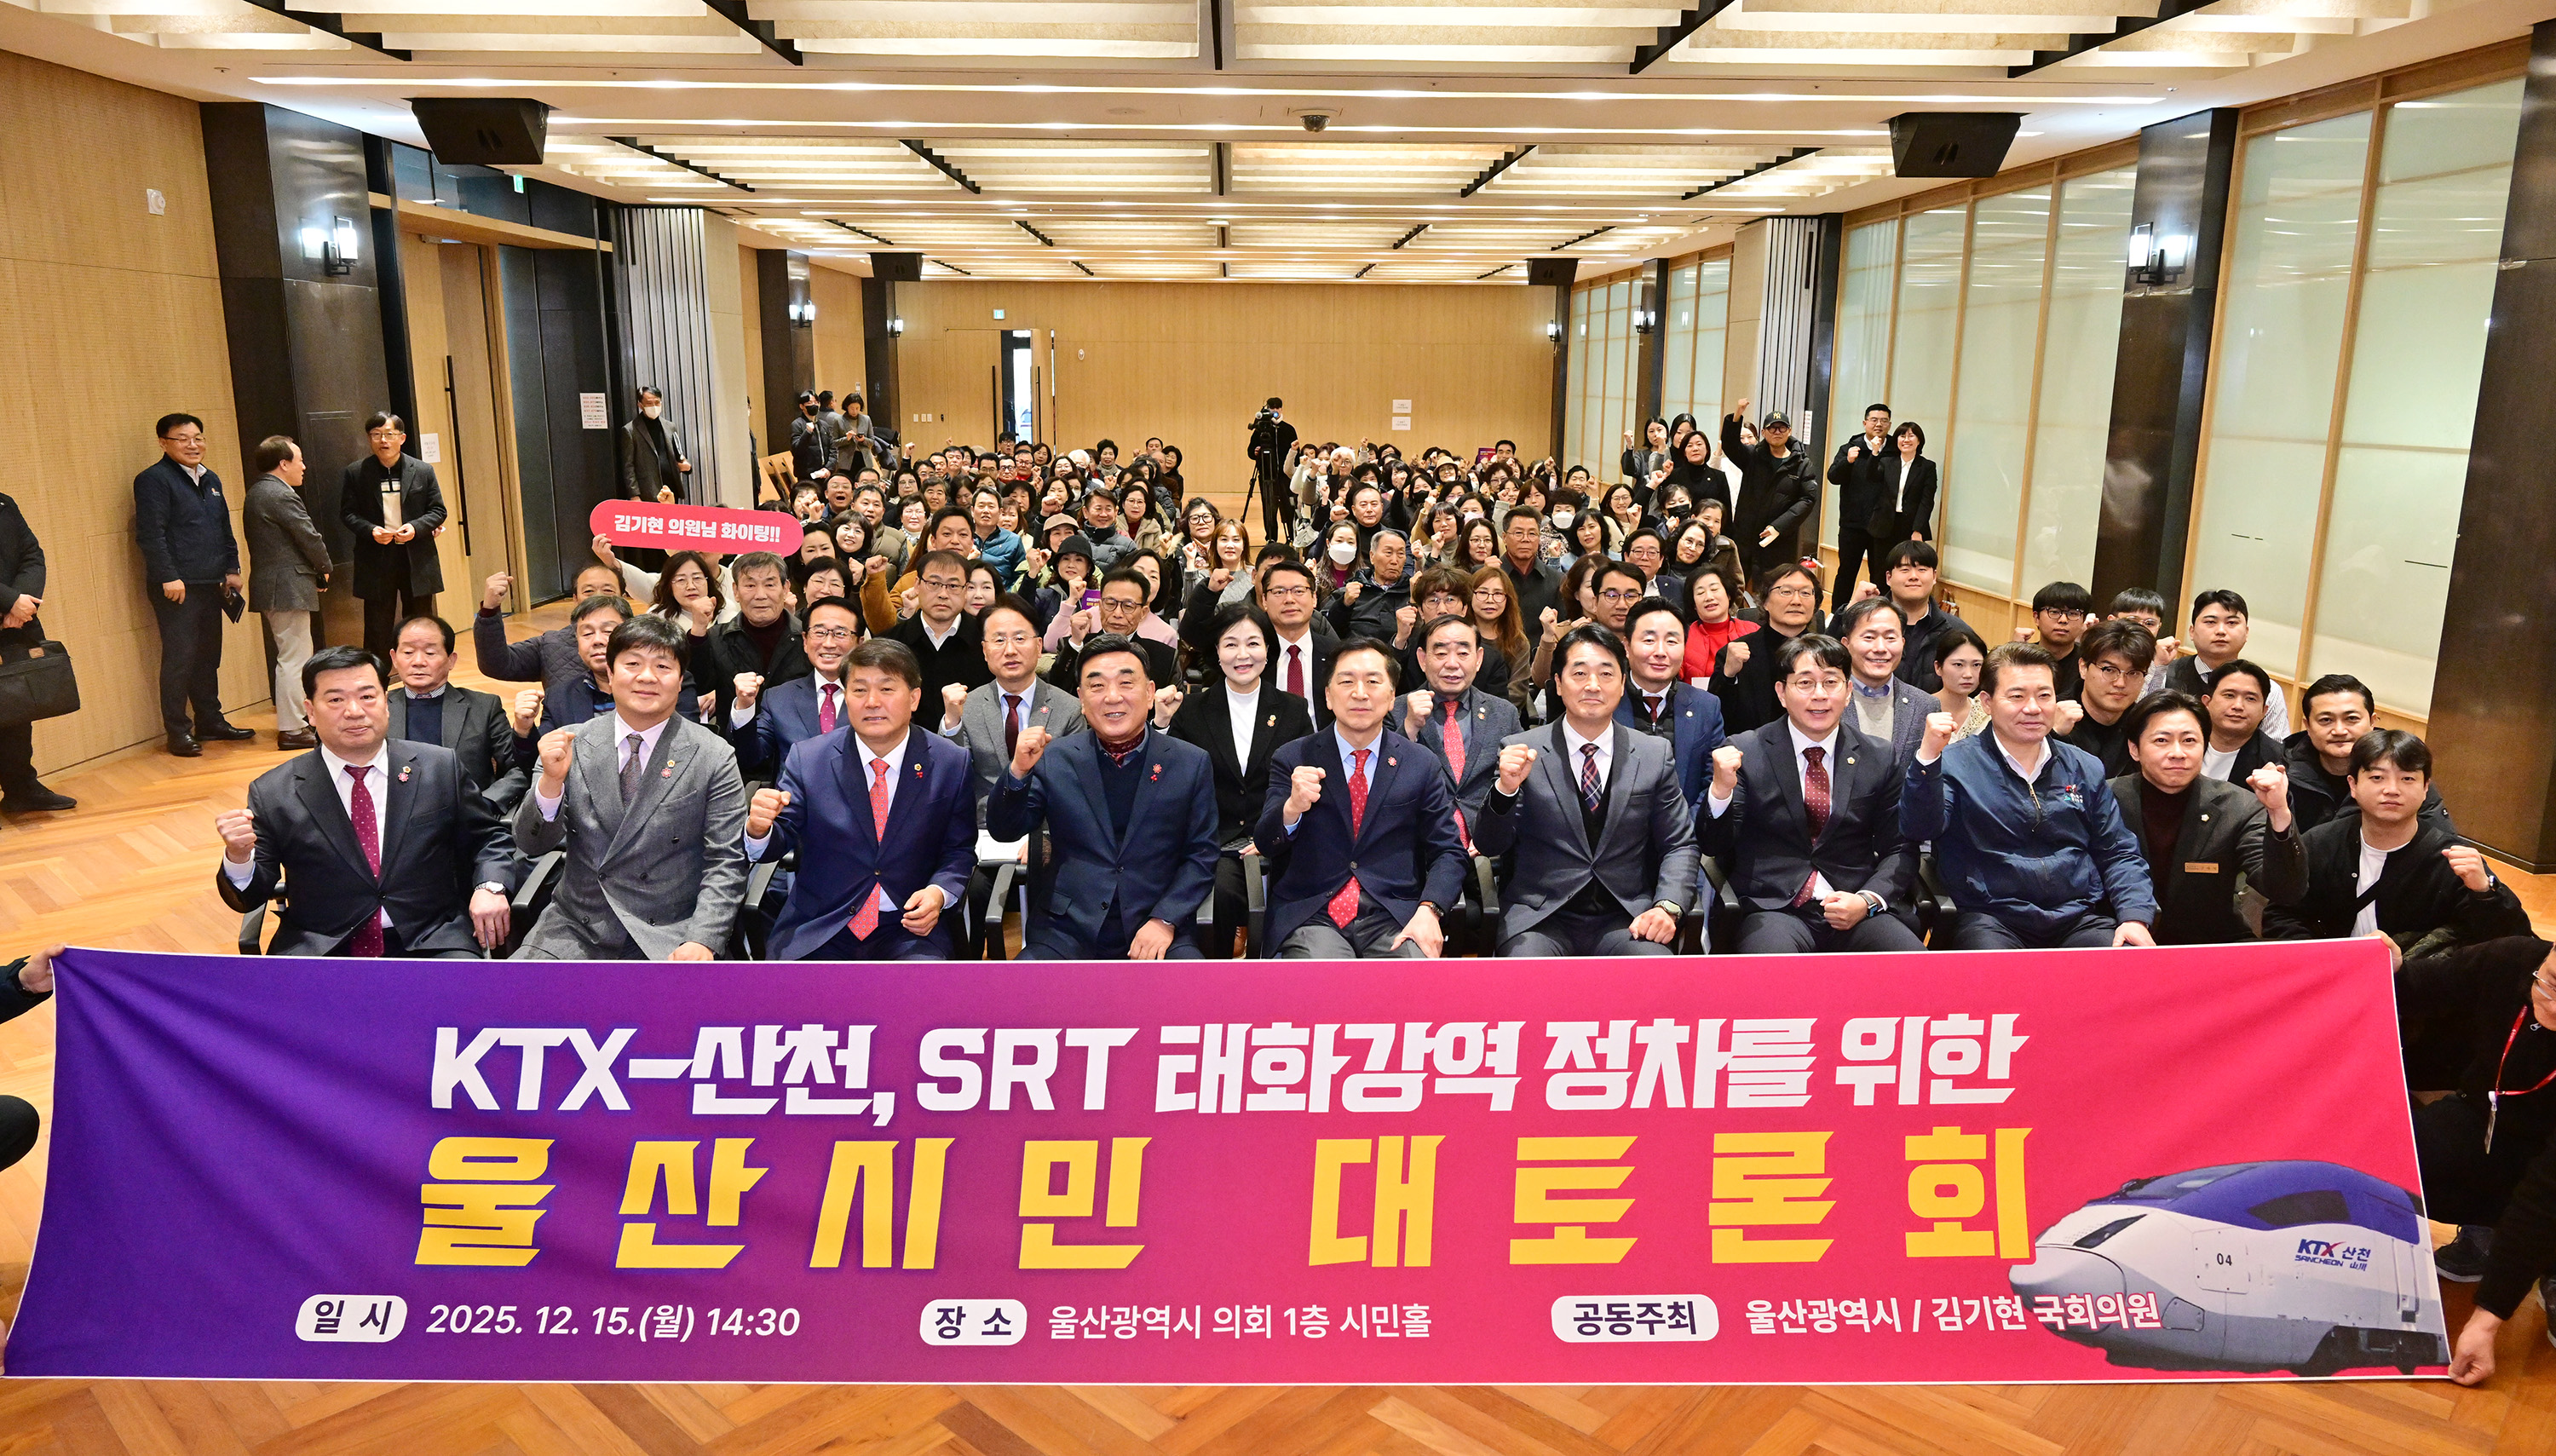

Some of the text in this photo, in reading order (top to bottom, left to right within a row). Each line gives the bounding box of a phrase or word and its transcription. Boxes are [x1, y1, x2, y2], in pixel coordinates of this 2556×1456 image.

[614, 515, 780, 543] 김기현 의원님 화이팅!!
[916, 1027, 1140, 1111] SRT
[1155, 1021, 1526, 1113] 태화강역
[1543, 1018, 1818, 1110] 정차를
[1835, 1013, 2030, 1106] 위한
[2217, 1252, 2232, 1266] 04
[2294, 1255, 2344, 1267] SANCHEON
[2297, 1239, 2346, 1257] KTX
[2342, 1246, 2371, 1262] 산천
[427, 1304, 522, 1334] 2025.
[537, 1306, 579, 1335] 12.
[594, 1304, 694, 1343] 15.(월)
[707, 1308, 800, 1336] 14:30
[1048, 1305, 1201, 1339] 울산광역시
[1212, 1304, 1272, 1338] 의회
[1284, 1305, 1330, 1338] 1층
[1339, 1303, 1432, 1338] 시민홀
[1573, 1301, 1697, 1335] 공동주최
[1746, 1297, 1901, 1334] 울산광역시
[1931, 1295, 2027, 1332] 김기현
[2033, 1292, 2162, 1331] 국회의원
